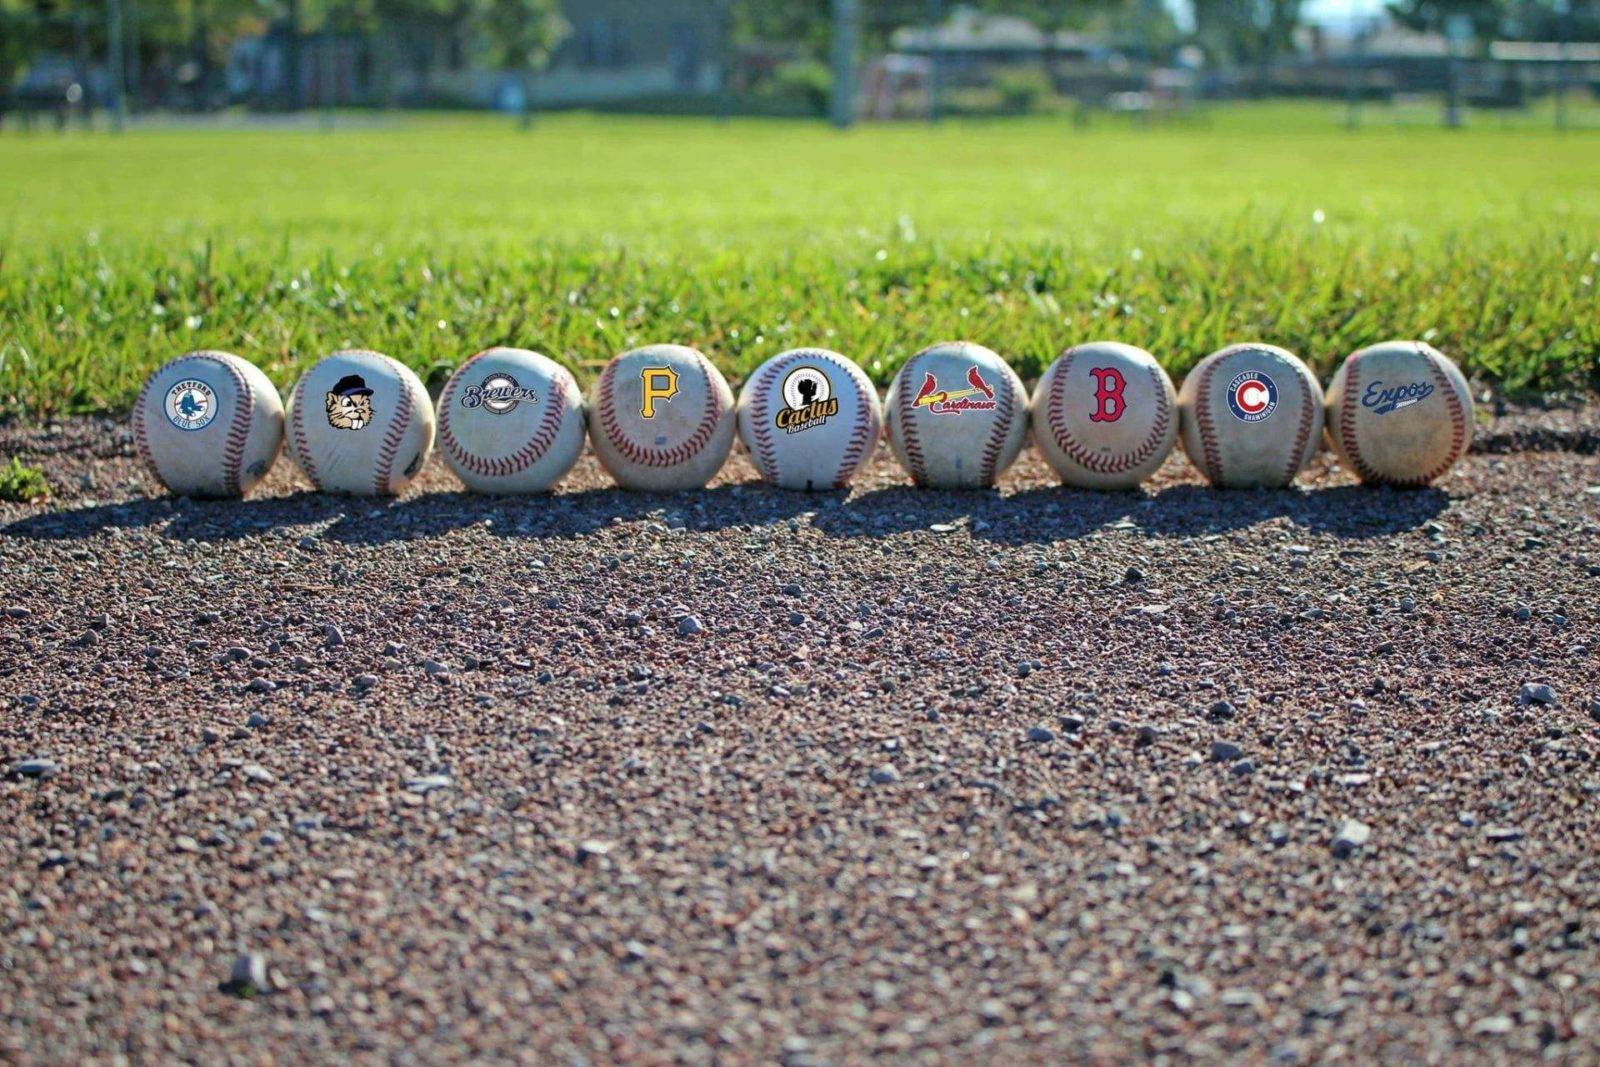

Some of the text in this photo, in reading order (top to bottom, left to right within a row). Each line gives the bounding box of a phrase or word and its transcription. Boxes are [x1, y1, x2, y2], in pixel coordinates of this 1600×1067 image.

[461, 384, 539, 409] Brewers
[640, 365, 680, 419] P
[1089, 367, 1127, 422] B
[1230, 372, 1259, 392] CASCADES
[1236, 380, 1267, 414] C
[1362, 381, 1435, 415] Expos
[777, 398, 838, 428] Cactus
